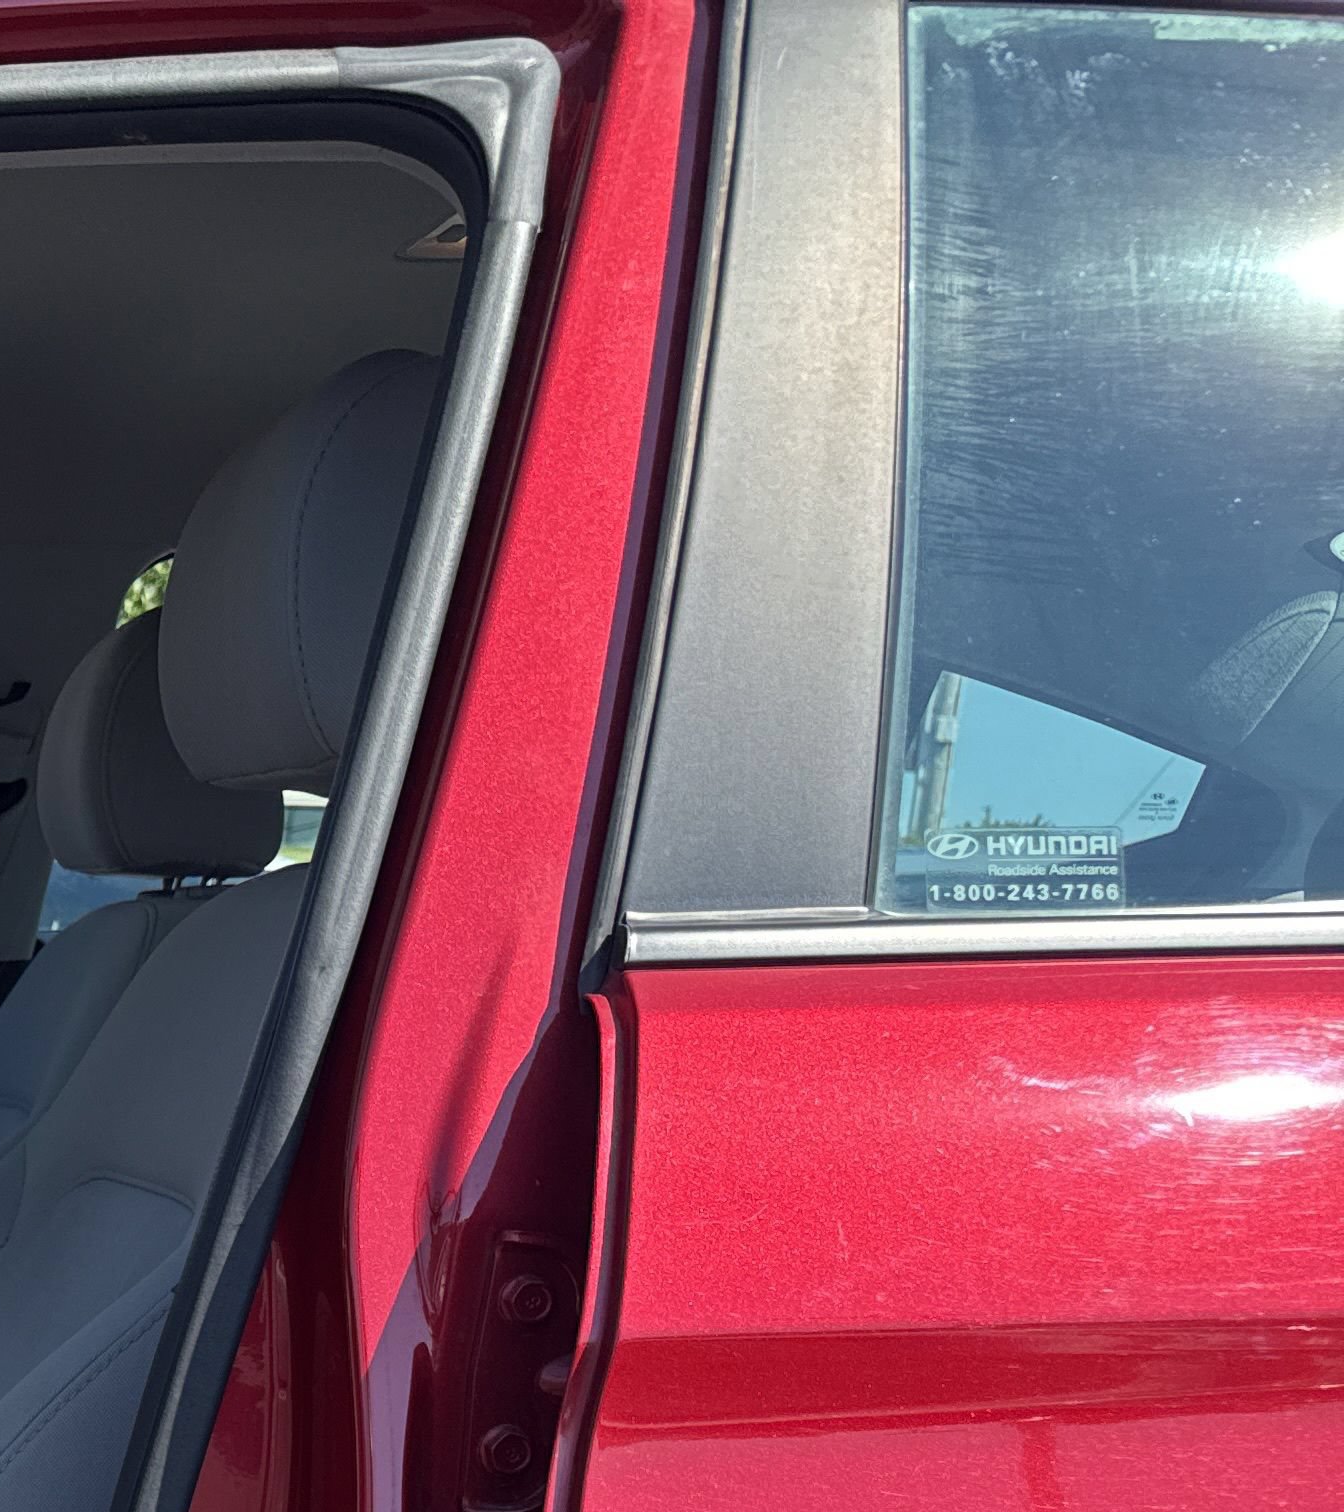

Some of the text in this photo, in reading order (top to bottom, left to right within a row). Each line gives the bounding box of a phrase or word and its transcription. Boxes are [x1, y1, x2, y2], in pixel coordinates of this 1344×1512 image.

[987, 836, 1117, 855] HYUNDAI
[988, 864, 1118, 876] Roadside Assistance
[929, 885, 1119, 901] 1-800-243-7766
